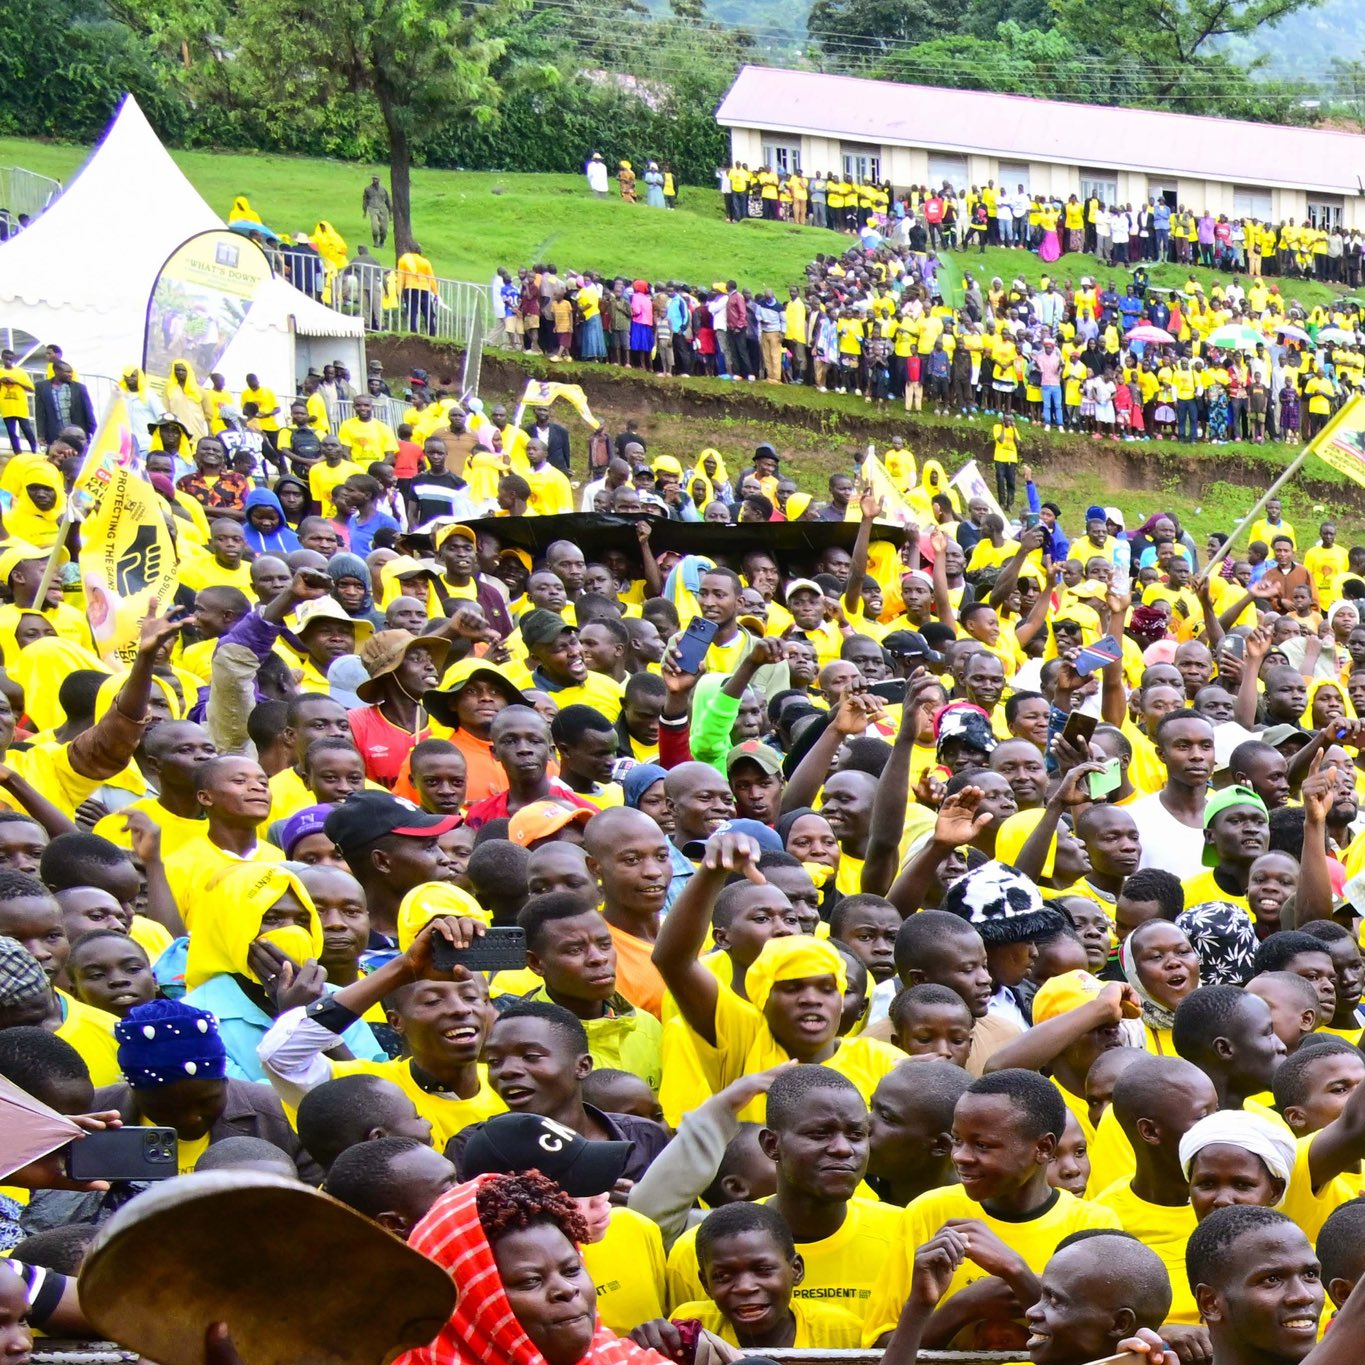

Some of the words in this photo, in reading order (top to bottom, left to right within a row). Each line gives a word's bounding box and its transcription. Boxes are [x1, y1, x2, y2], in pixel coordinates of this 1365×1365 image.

[106, 470, 128, 540] PROTECTING
[105, 543, 115, 565] THE
[793, 1287, 857, 1299] PRESIDENT
